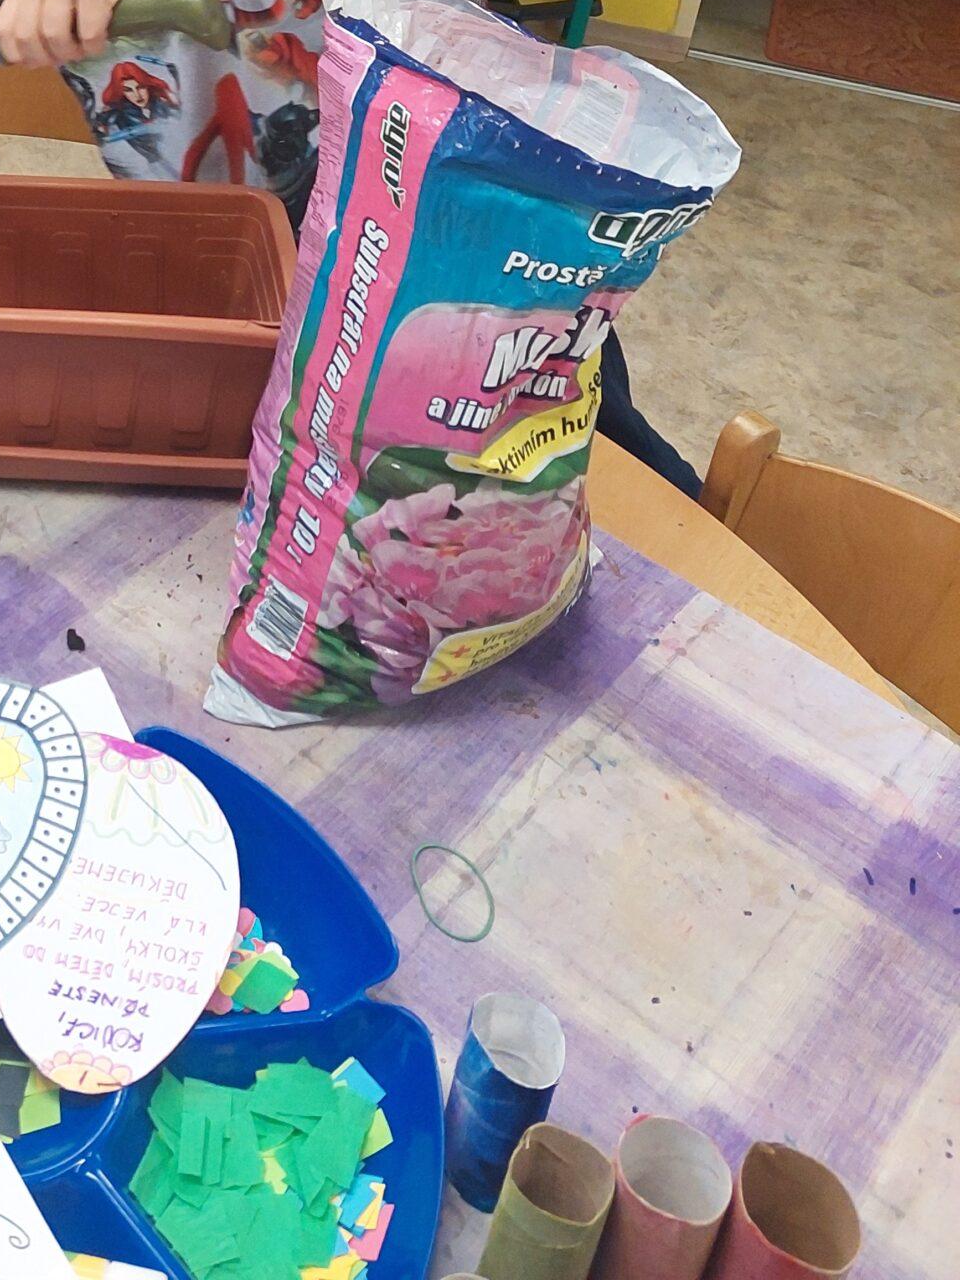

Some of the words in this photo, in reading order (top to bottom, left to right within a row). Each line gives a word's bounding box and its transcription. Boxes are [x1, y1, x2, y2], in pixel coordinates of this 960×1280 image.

[381, 101, 411, 202] agro
[324, 344, 351, 392] na
[492, 428, 556, 475] ktivním
[292, 506, 321, 555] 10
[23, 944, 46, 962] DO
